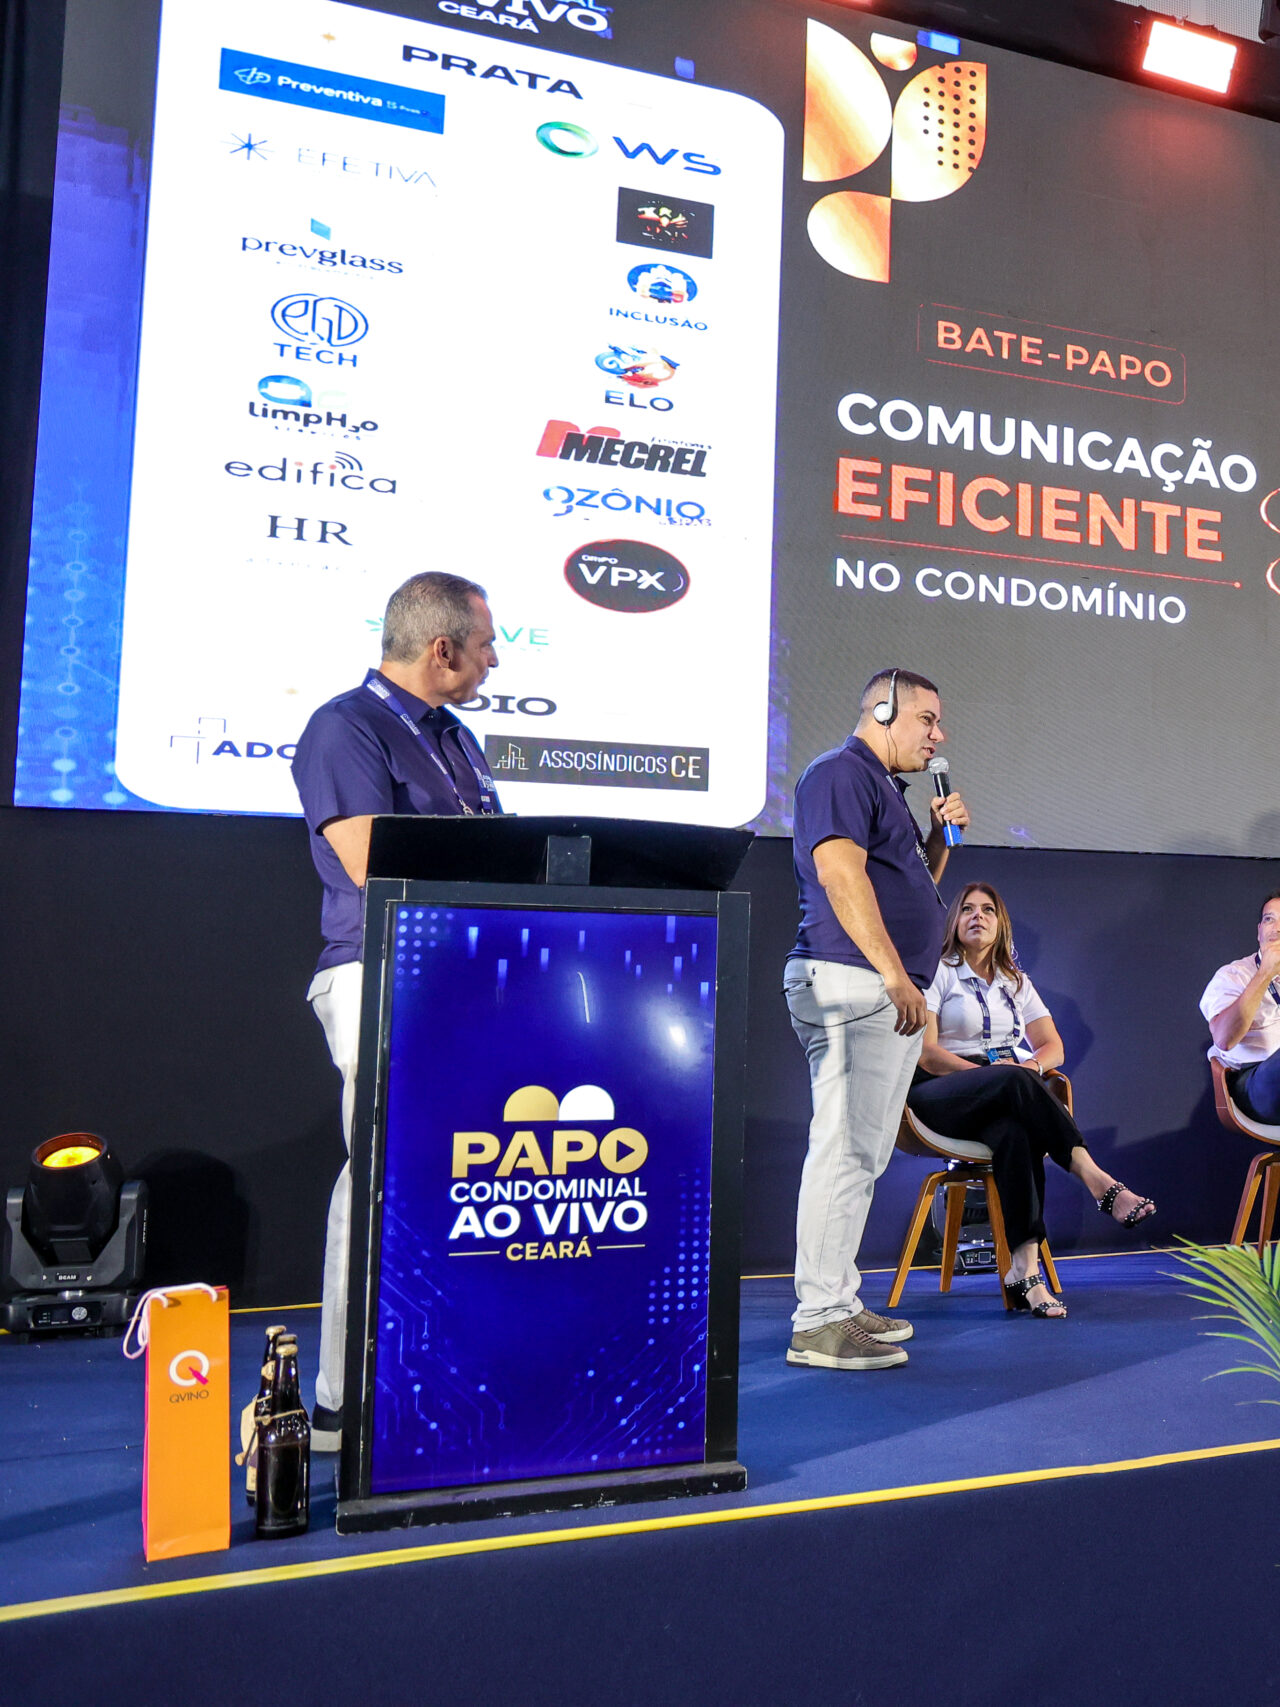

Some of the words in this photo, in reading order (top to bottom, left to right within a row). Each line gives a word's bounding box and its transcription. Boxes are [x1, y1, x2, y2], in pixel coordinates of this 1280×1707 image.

[277, 75, 383, 108] Preventiva
[402, 44, 584, 101] PRATA
[612, 136, 722, 176] WS
[241, 236, 404, 275] prevglass
[273, 342, 358, 368] TECH
[936, 319, 1172, 388] BATE-PAPO
[604, 389, 674, 412] ELO
[558, 431, 708, 478] MECREL
[836, 392, 1258, 494] COMUNICAÇÃO
[224, 456, 397, 494] edifica
[836, 456, 1224, 562] EFICIENTE
[266, 514, 353, 546] HR
[578, 562, 666, 592] VPX
[834, 556, 901, 593] NO
[914, 566, 1187, 625] CONDOMÍNIO
[538, 749, 668, 774] ASSOSÍNDICOS
[670, 755, 702, 779] CE
[452, 1127, 649, 1178] PAPO
[450, 1176, 647, 1203] CONDOMINIAL
[448, 1204, 521, 1240] AO
[533, 1199, 648, 1236] VIVO
[506, 1235, 592, 1261] CEARÁ
[169, 1389, 210, 1404] QVINO
